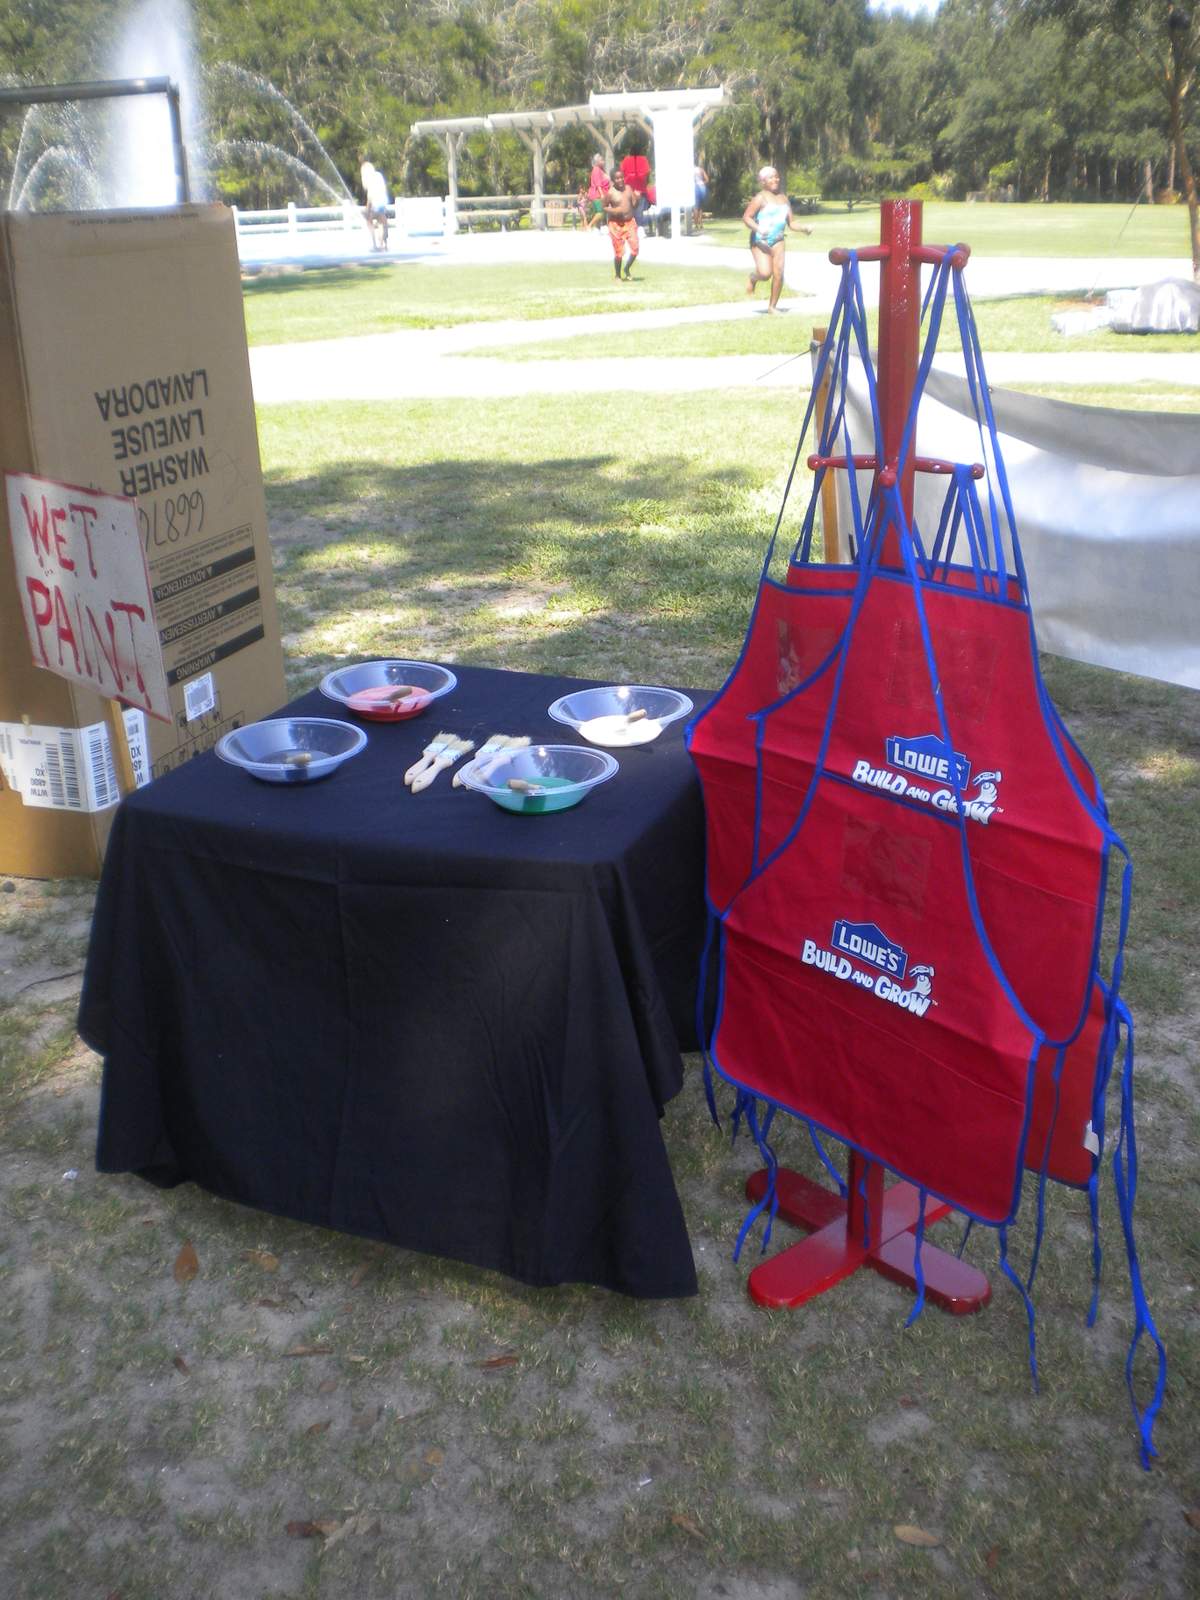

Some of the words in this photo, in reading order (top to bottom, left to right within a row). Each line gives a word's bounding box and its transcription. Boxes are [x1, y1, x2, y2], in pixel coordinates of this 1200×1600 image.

[94, 369, 209, 421] LAVADORA
[112, 408, 205, 460] LAVEUSE
[120, 446, 209, 498] WASHER
[20, 493, 98, 579] WET
[155, 567, 206, 599] ADVERTENCIA
[26, 576, 147, 702] PAINT
[160, 608, 217, 641] AVERTISSEMEN
[176, 652, 213, 680] WARNING
[852, 760, 908, 796] BUILD
[905, 786, 931, 802] AND
[839, 926, 899, 972] LOWE'S
[801, 939, 852, 980] BUILD
[851, 970, 874, 989] AND
[874, 975, 931, 1018] GROW
